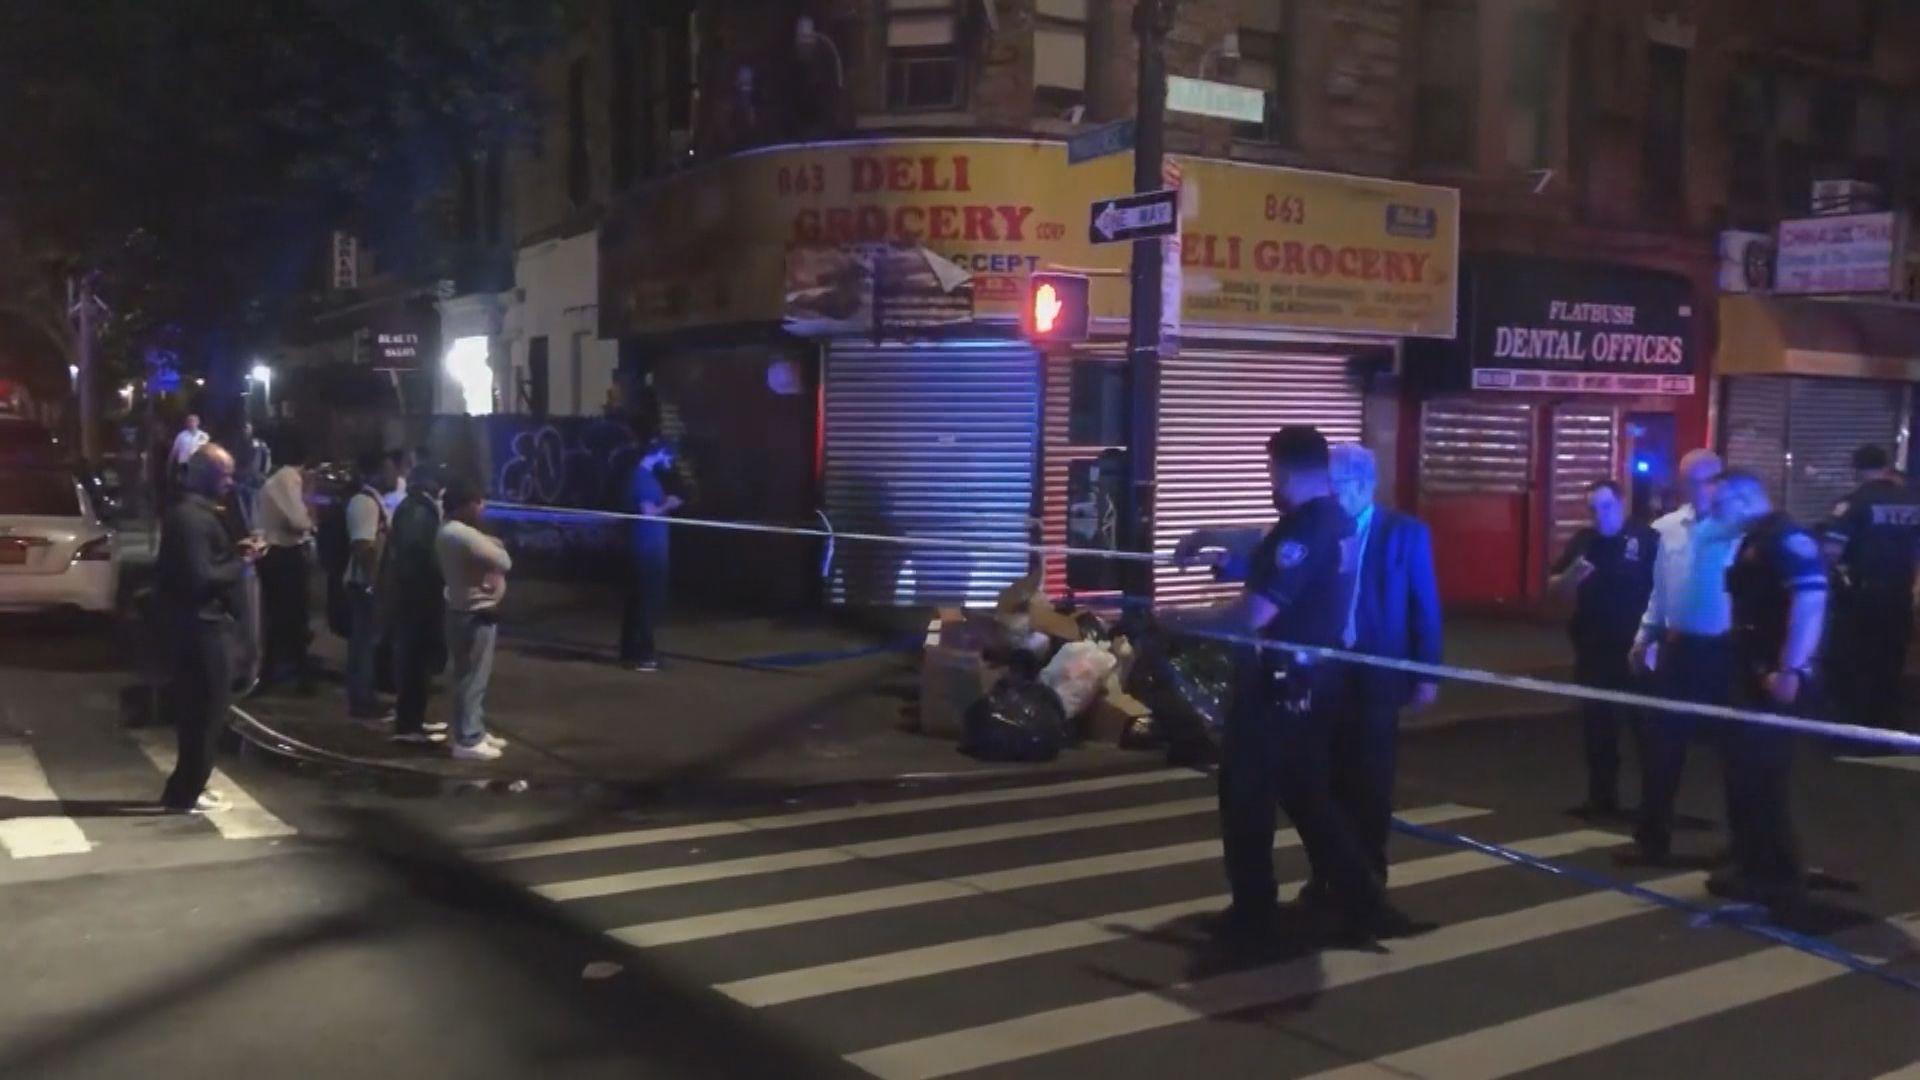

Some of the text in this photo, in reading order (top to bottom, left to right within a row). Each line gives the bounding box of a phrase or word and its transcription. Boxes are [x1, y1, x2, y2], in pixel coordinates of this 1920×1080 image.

[851, 155, 972, 193] DELI
[795, 205, 1033, 242] GROCERY
[1264, 193, 1305, 225] 863
[1181, 232, 1429, 283] ELI GROCERY
[1549, 300, 1636, 325] FLATBUSH
[1494, 326, 1684, 364] DENTAL OFFICES
